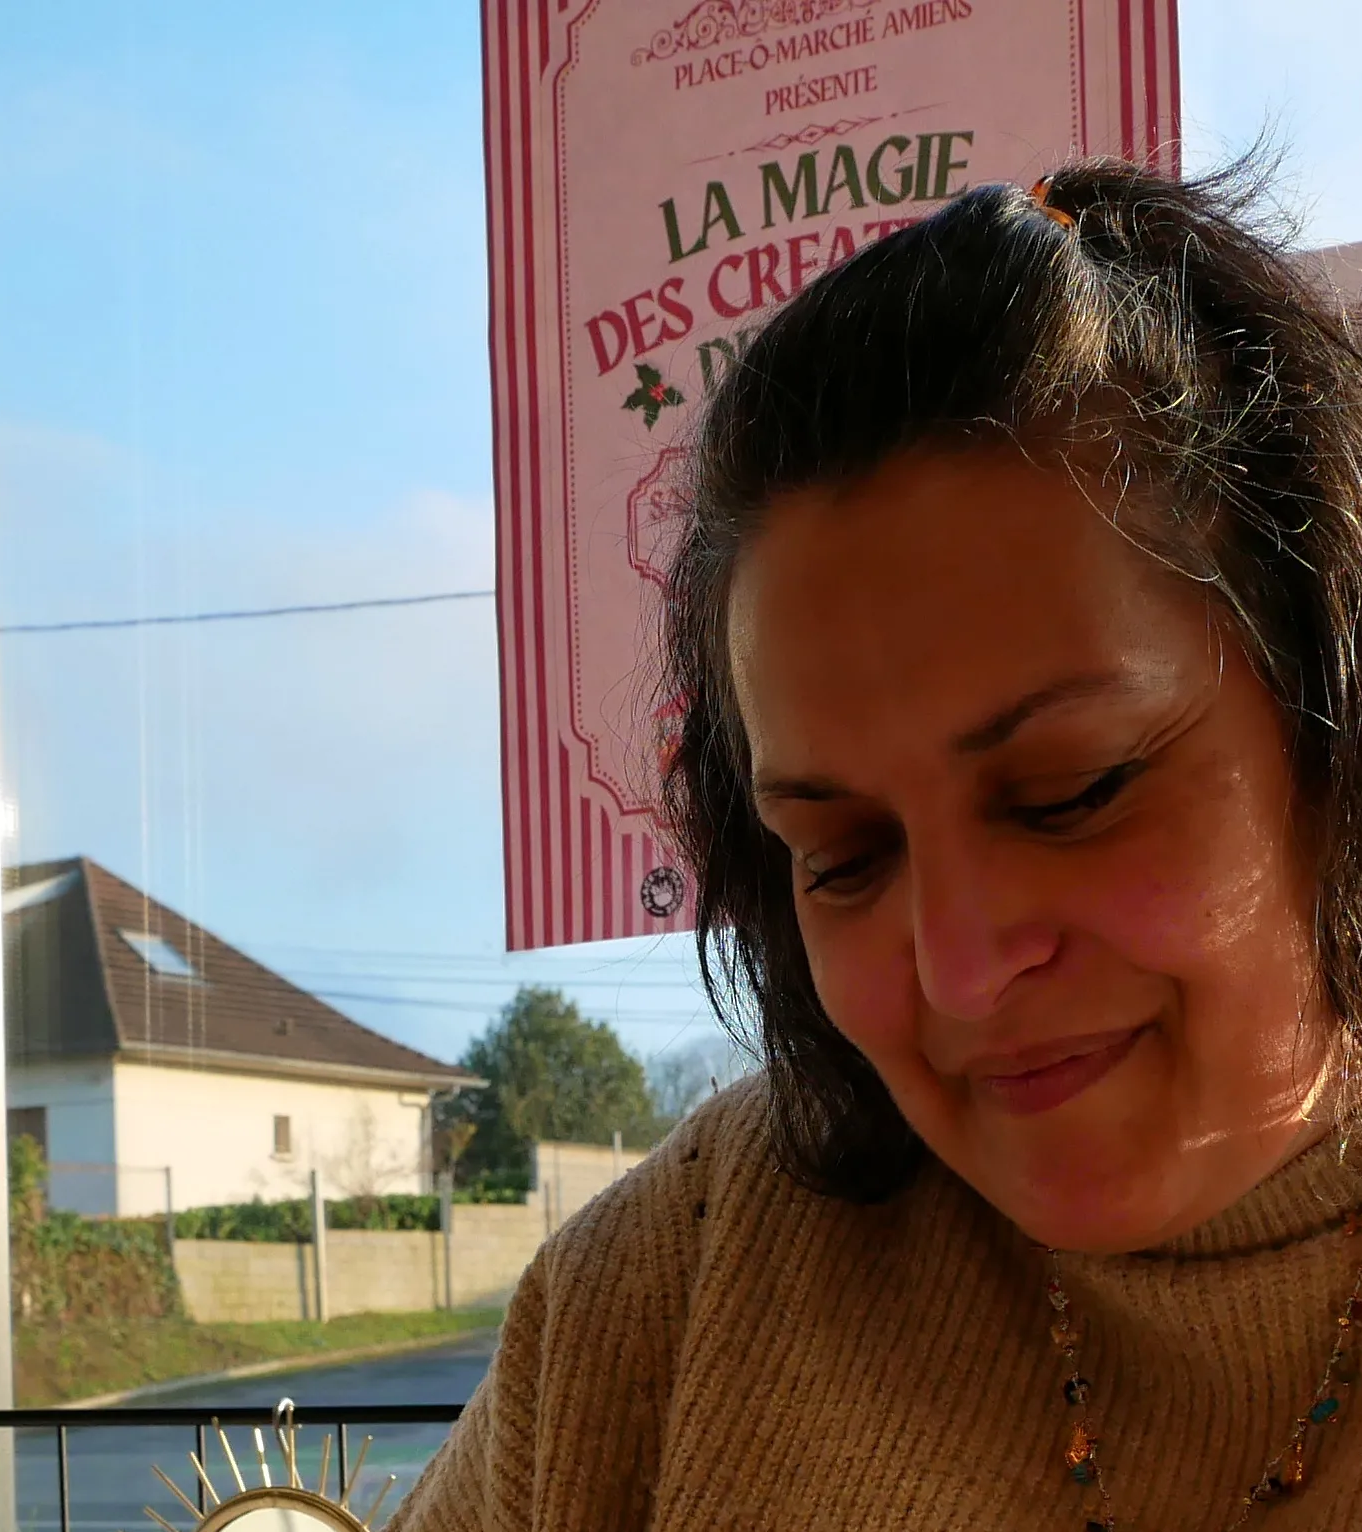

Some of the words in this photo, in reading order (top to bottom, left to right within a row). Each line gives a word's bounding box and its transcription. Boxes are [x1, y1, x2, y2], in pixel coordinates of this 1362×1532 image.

[882, 1, 972, 42] AMIENS
[764, 65, 878, 116] PRÉSENTE
[658, 181, 745, 264] LA
[758, 131, 974, 229] MAGIE
[583, 277, 695, 378] DES
